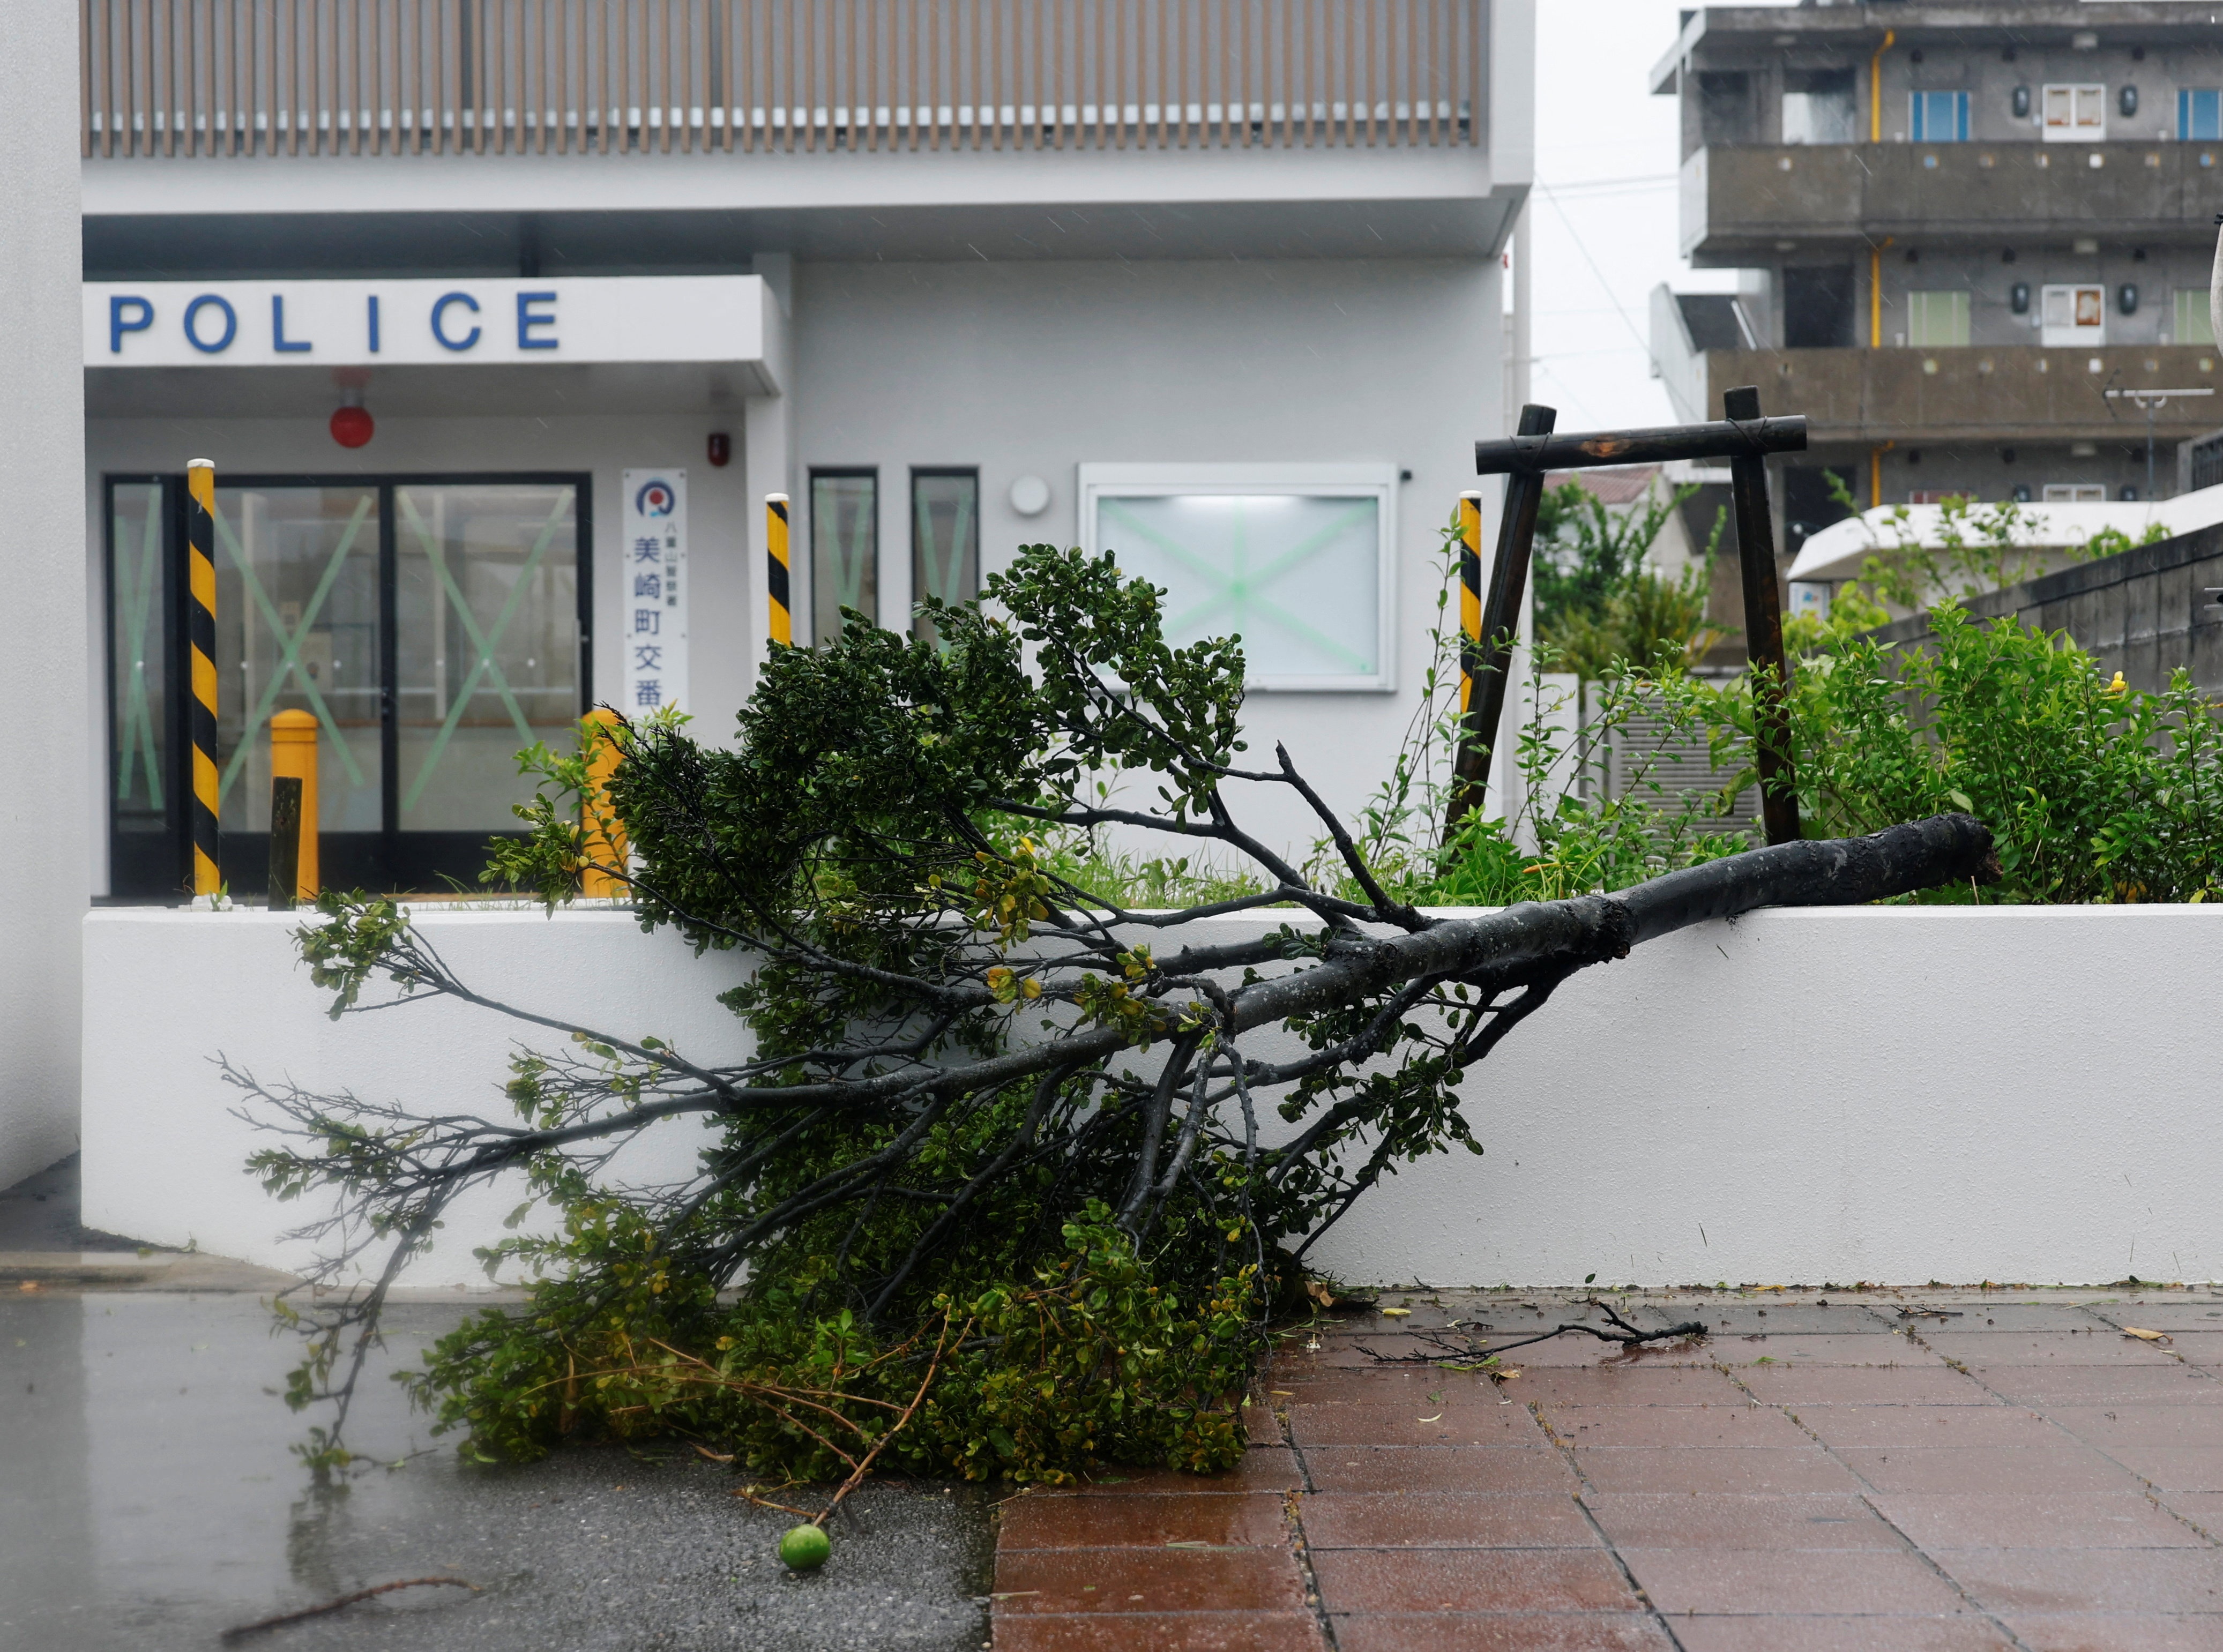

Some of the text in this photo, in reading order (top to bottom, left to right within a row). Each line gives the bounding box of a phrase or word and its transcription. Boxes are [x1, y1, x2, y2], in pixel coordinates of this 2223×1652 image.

[110, 292, 559, 353] POLICE
[635, 536, 662, 706] 美崎町交番
